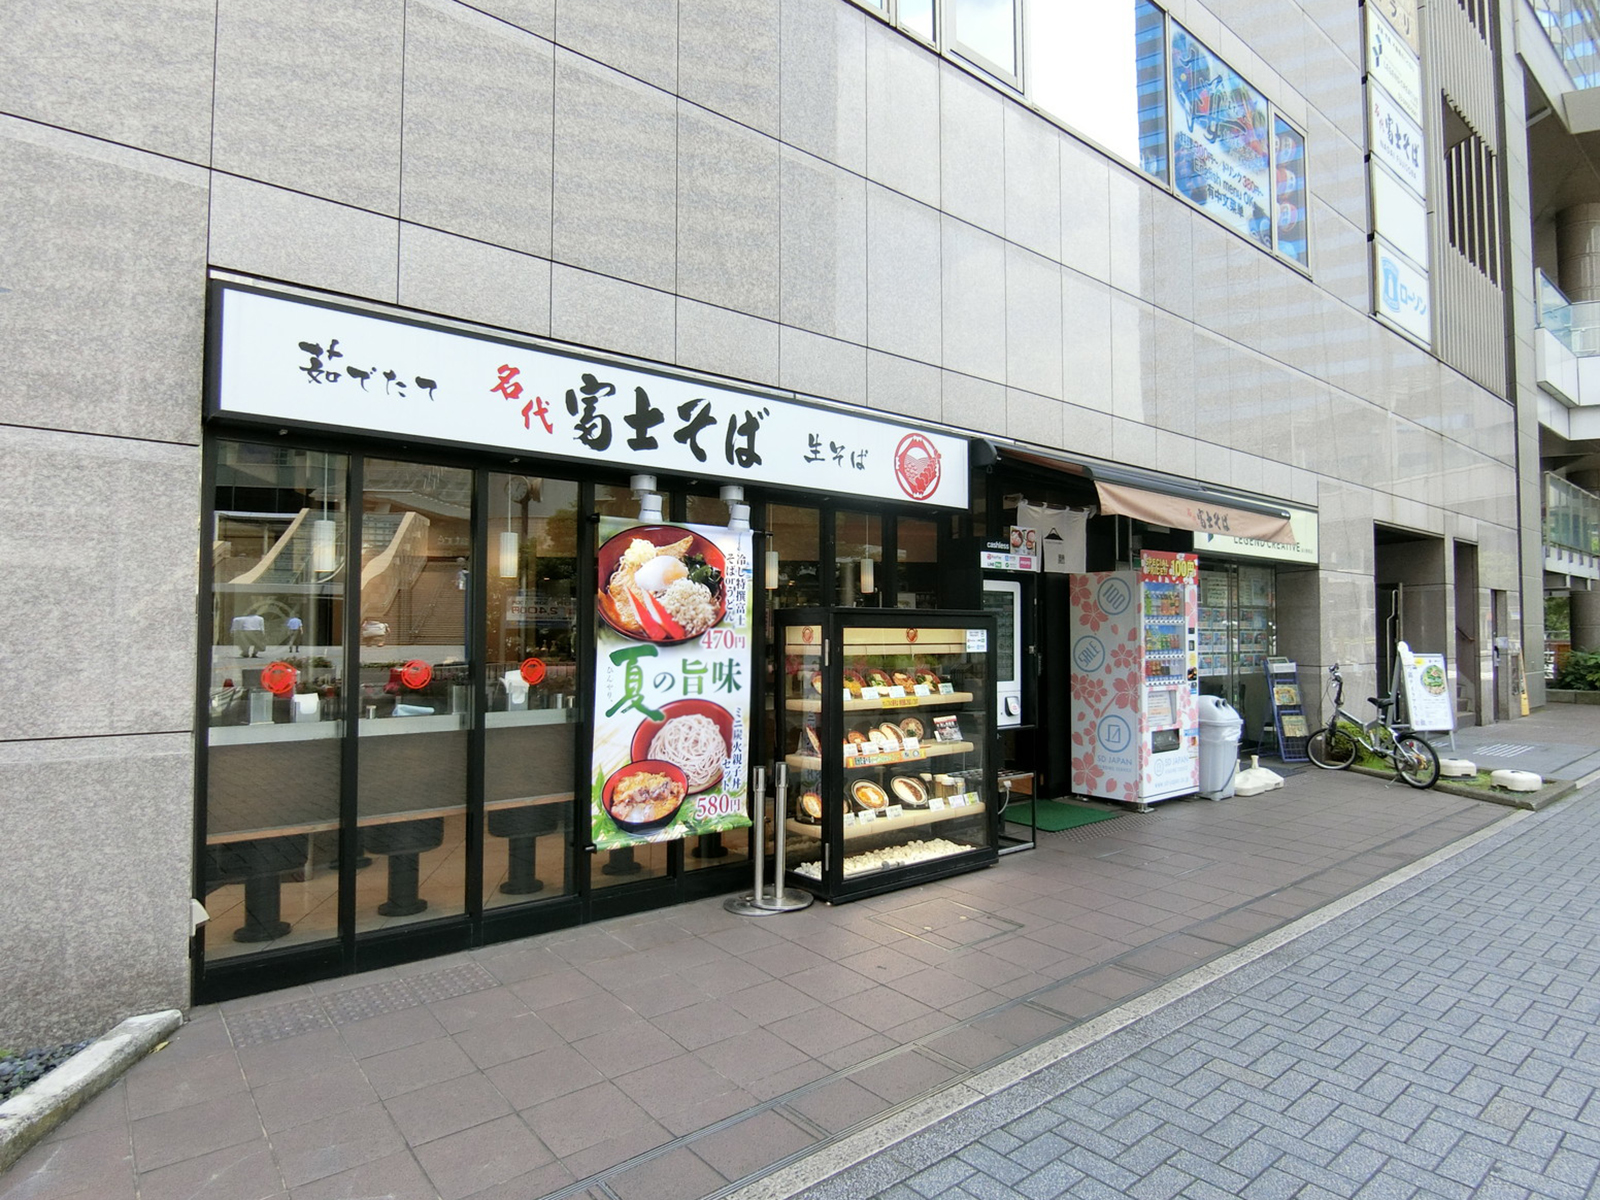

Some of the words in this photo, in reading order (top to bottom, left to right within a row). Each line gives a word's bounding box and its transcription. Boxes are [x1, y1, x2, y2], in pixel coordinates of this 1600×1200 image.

[1400, 283, 1427, 316] ローソン
[298, 338, 437, 401] 茹でたて
[490, 363, 553, 434] 名代
[565, 372, 770, 468] 富士そば
[803, 433, 869, 471] 生そば
[986, 541, 1010, 550] cashless
[725, 553, 735, 622] そばorうどん
[701, 629, 745, 650] 470円
[605, 644, 742, 721] 夏の旨味
[732, 707, 743, 790] ミニ炭火親子丼
[1108, 756, 1133, 766] JAPAN
[722, 759, 732, 791] セット
[696, 794, 742, 818] 580円
